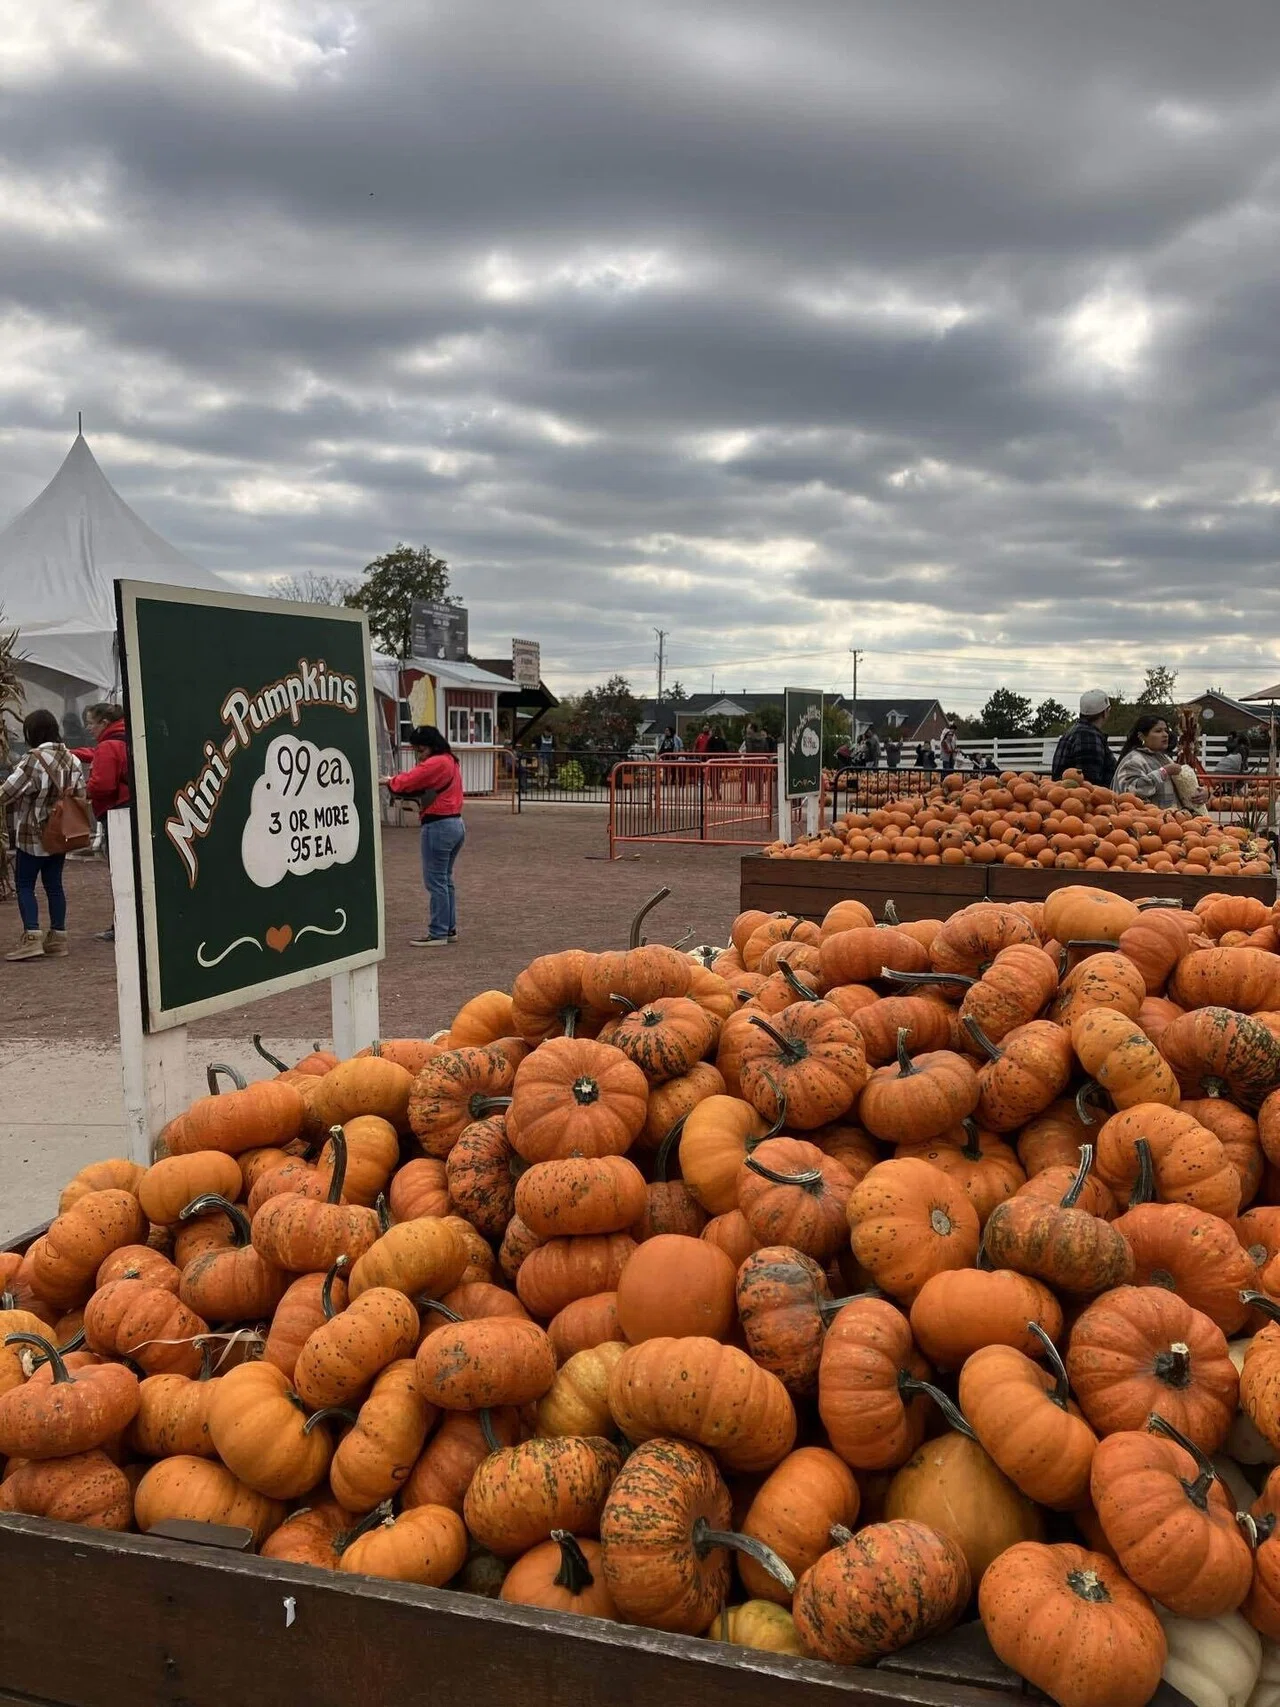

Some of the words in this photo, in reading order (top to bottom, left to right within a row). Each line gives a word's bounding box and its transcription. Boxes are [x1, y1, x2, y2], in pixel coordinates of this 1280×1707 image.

[166, 660, 357, 886] Mini-Pumpkins
[266, 745, 311, 797] .99
[316, 757, 351, 788] ea.
[268, 811, 282, 835] 3
[289, 808, 310, 832] OR
[314, 804, 350, 829] MORE
[287, 835, 312, 864] .95
[314, 834, 337, 858] EA.
